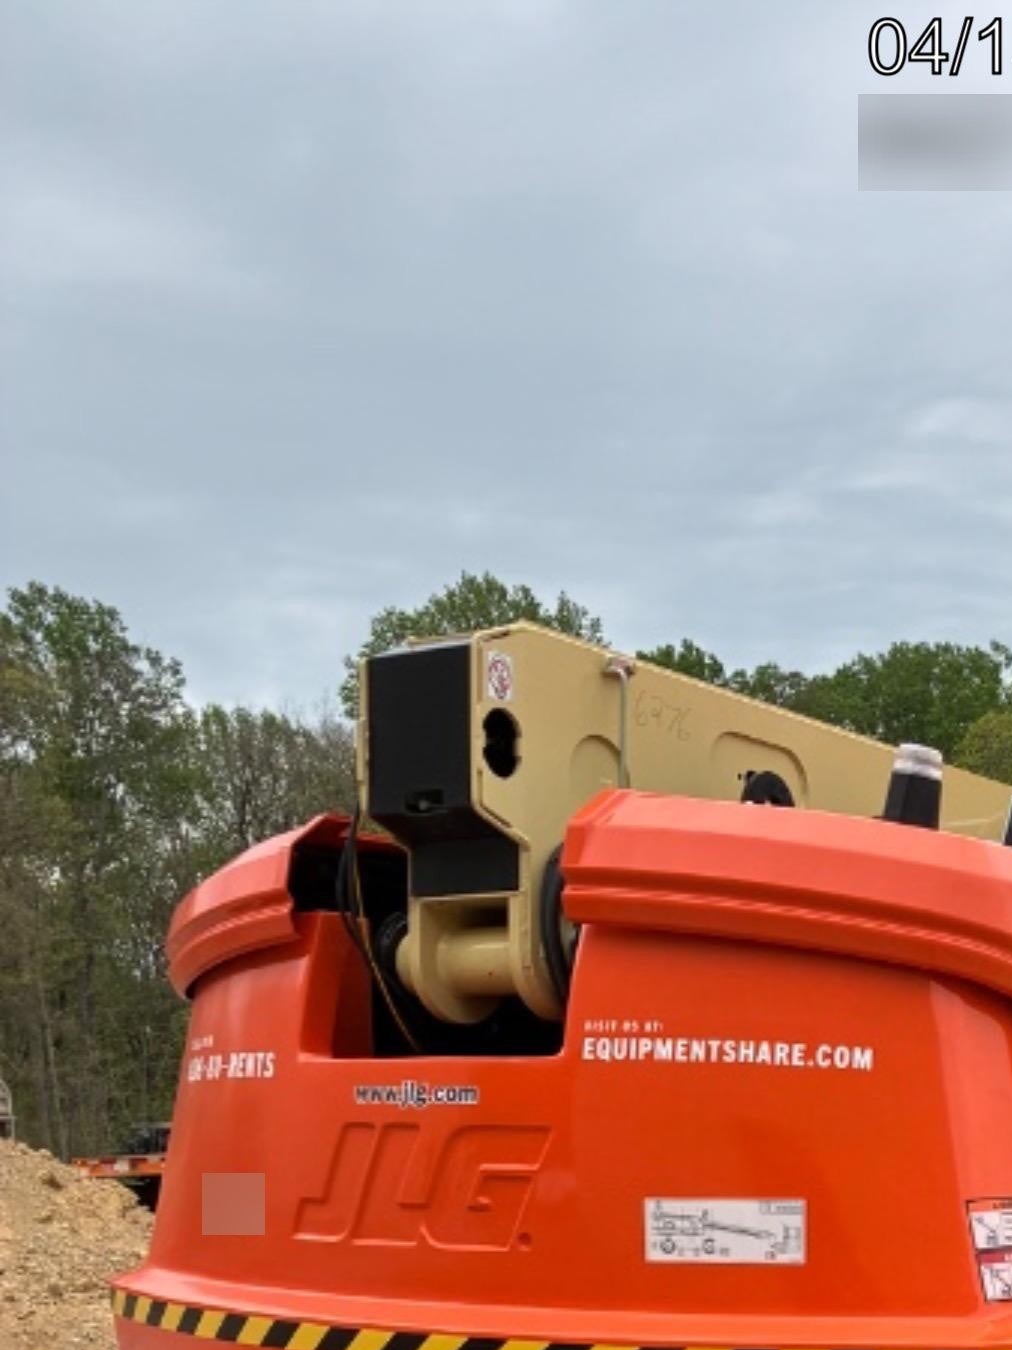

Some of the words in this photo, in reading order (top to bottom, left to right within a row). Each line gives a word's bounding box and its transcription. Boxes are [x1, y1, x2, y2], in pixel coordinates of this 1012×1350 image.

[581, 1037, 874, 1071] EQUIPMENTSHARE.COM
[354, 1079, 478, 1109] www.jlg.com
[292, 1121, 552, 1251] JLG
